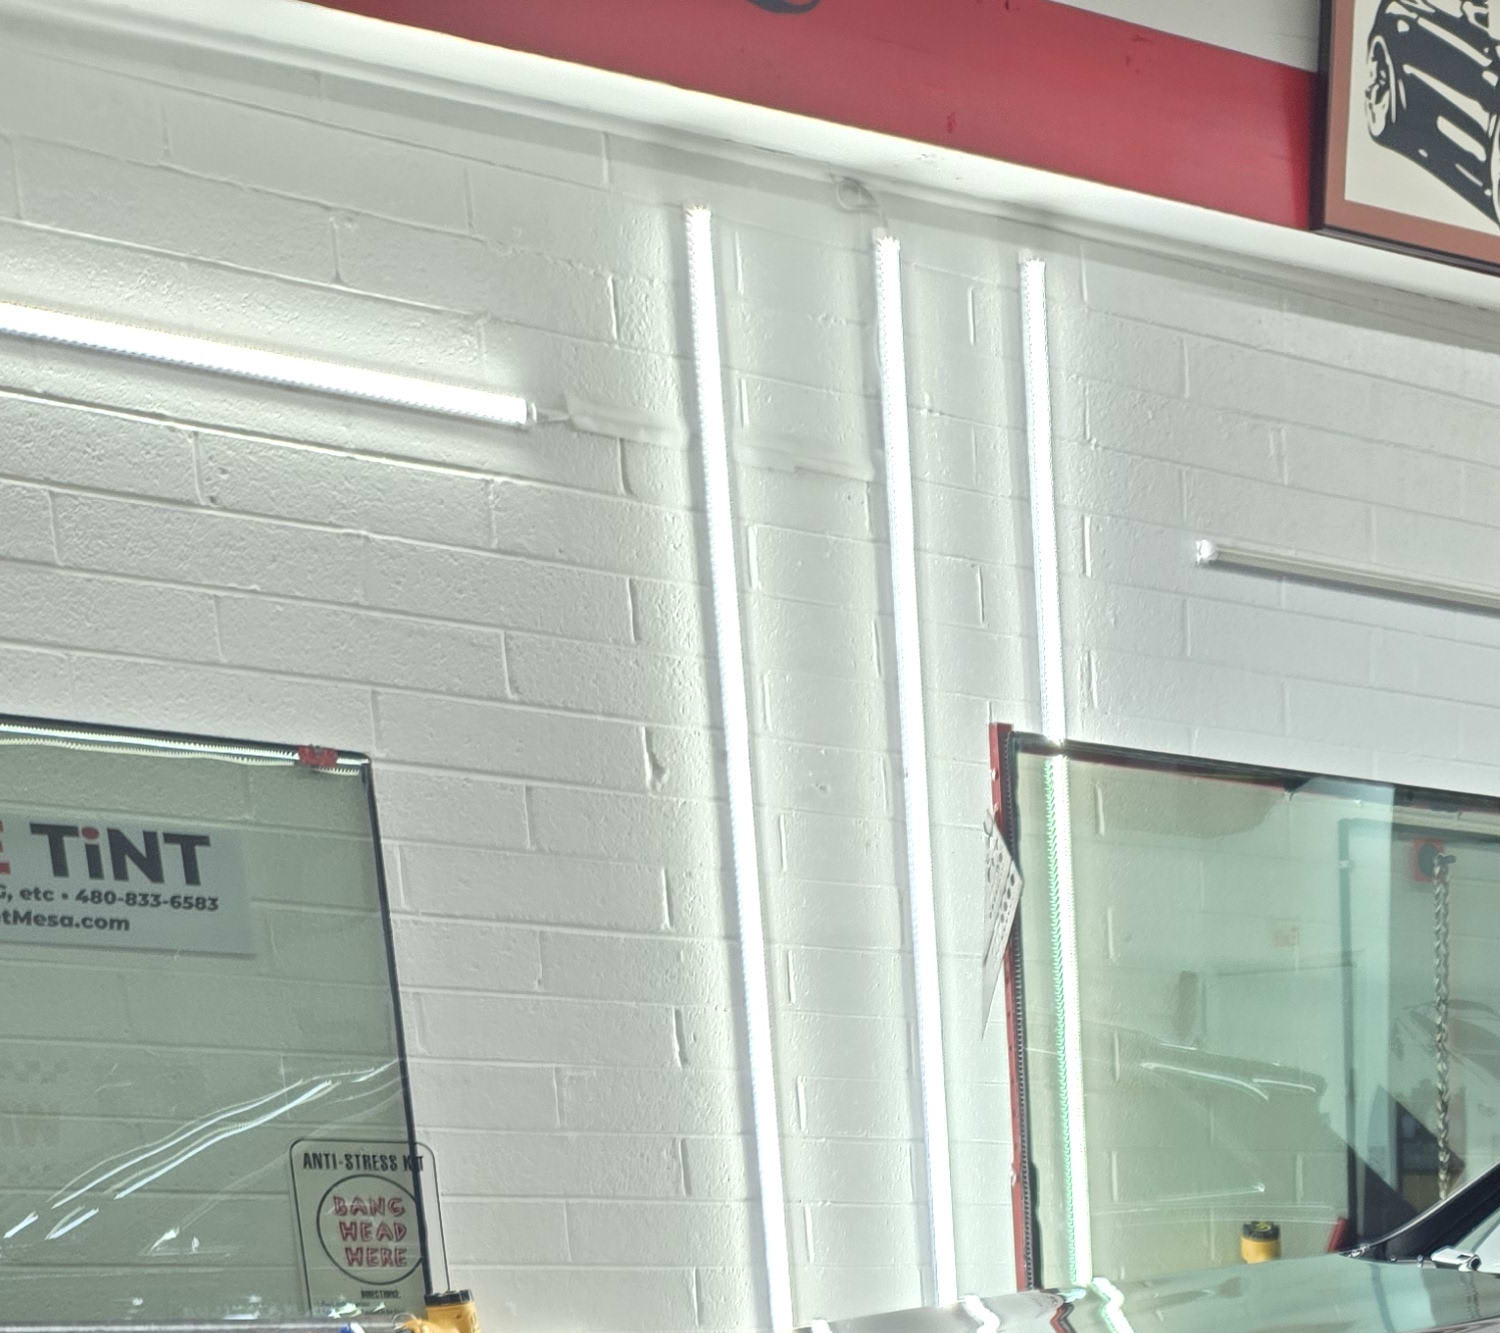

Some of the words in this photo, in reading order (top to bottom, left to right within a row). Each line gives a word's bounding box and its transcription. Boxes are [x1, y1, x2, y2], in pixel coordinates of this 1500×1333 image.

[29, 822, 211, 887] TiNT
[19, 886, 54, 902] etc
[75, 888, 219, 911] 480-833-6583
[2, 909, 130, 932] tMesa.com
[303, 1152, 398, 1171] ANTI-STRESS
[333, 1195, 406, 1217] BANG
[339, 1221, 407, 1242] HEAD
[345, 1246, 407, 1268] HERE
